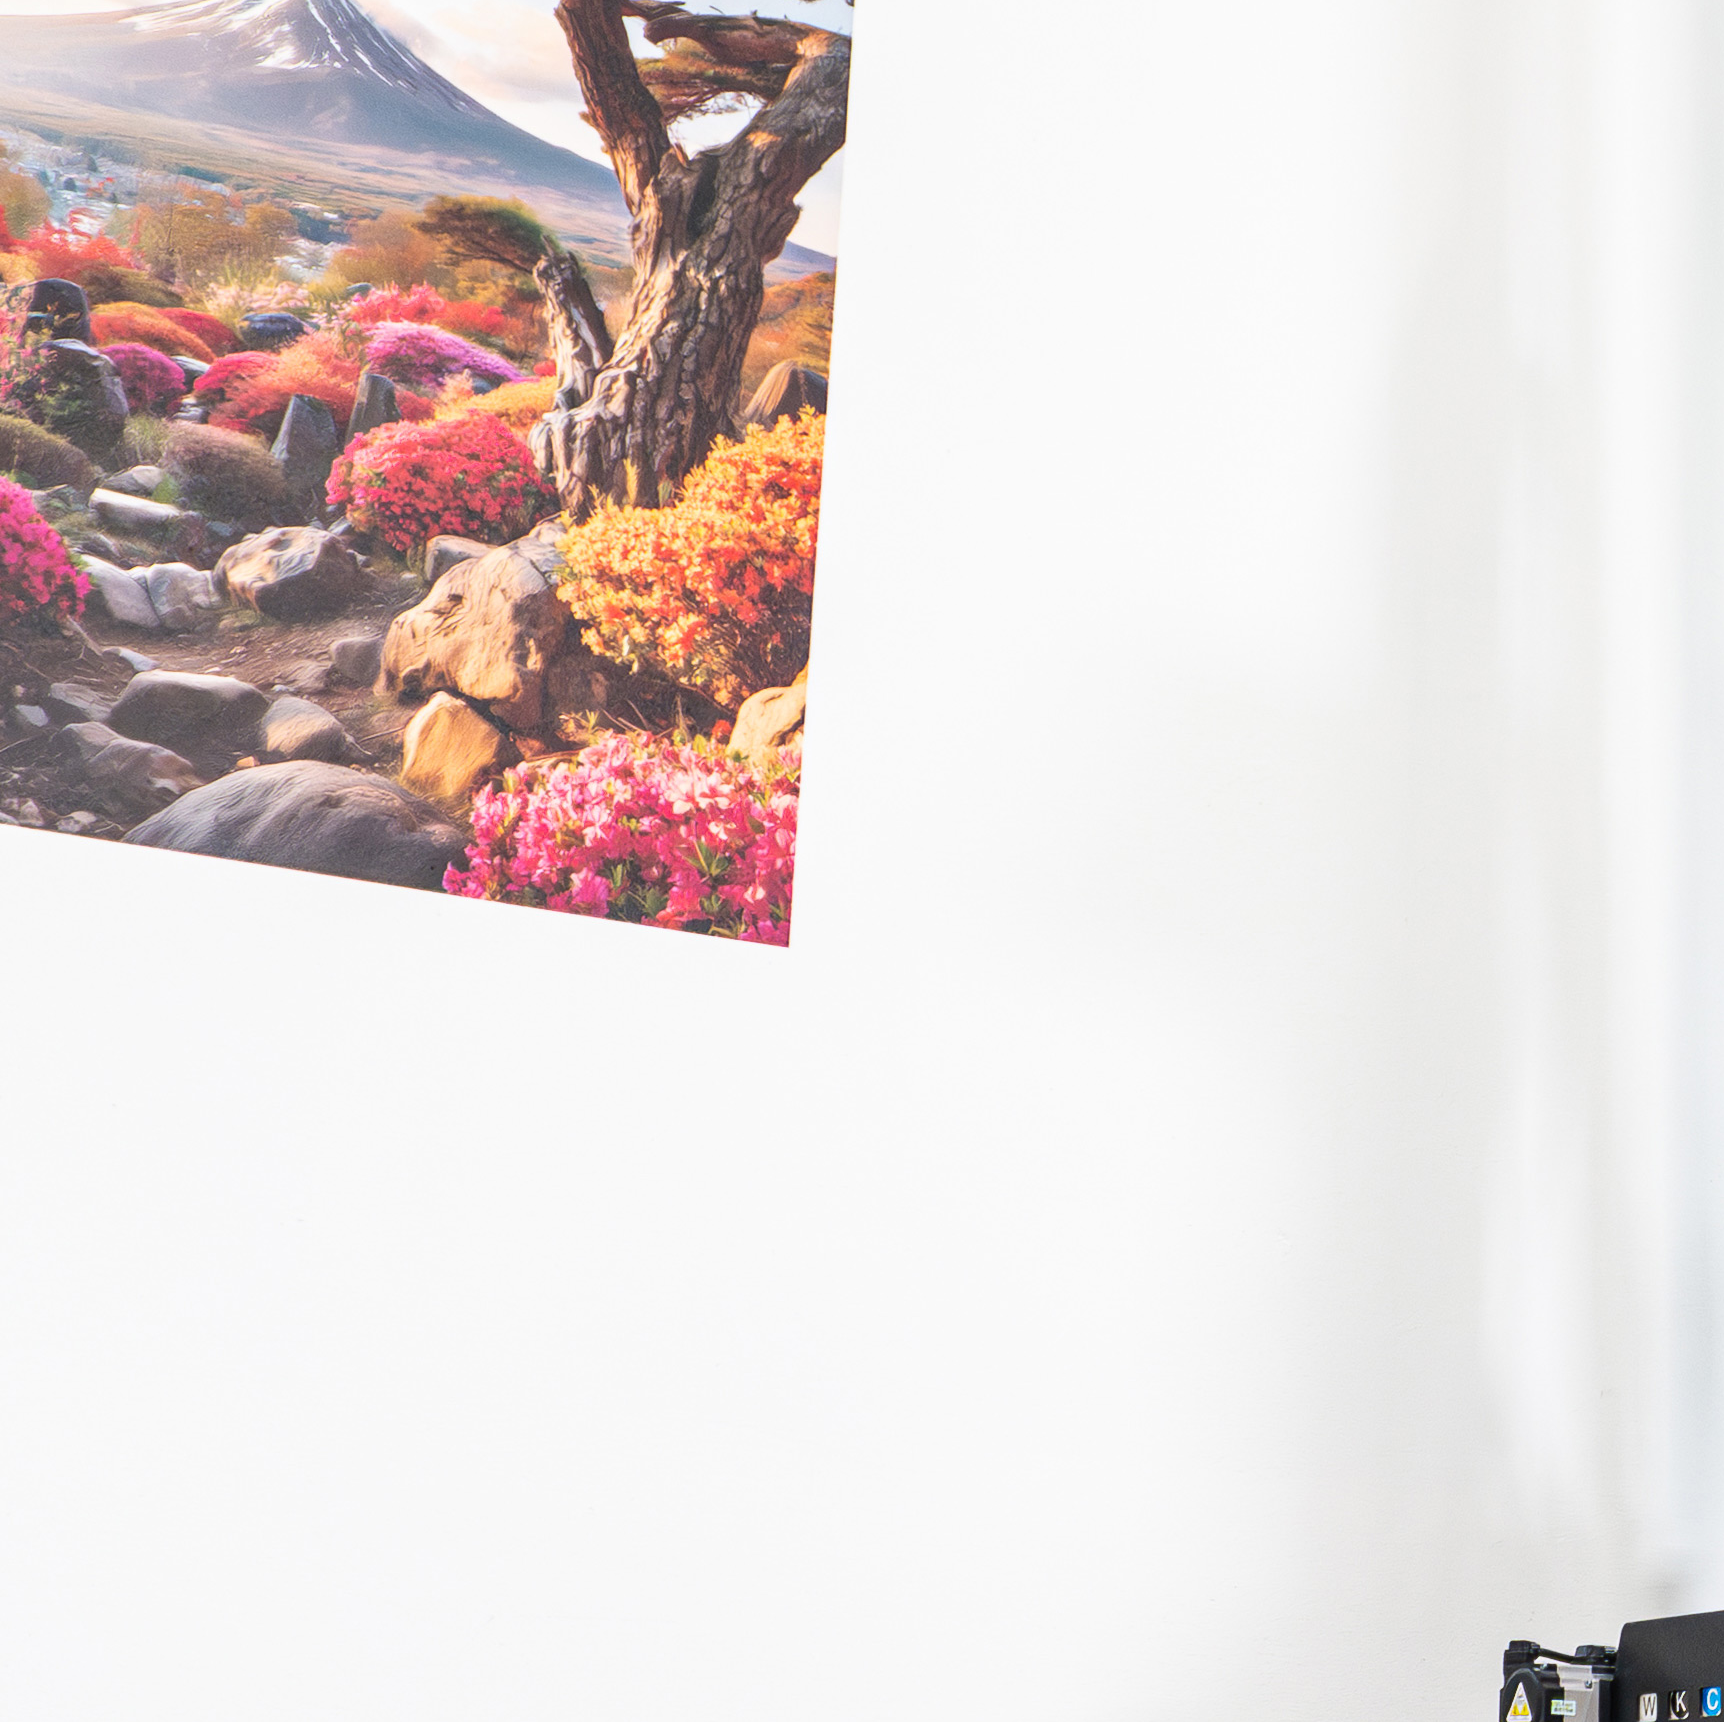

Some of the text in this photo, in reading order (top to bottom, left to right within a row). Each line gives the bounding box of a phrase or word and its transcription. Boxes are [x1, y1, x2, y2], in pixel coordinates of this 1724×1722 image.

[1643, 1695, 1656, 1717] W
[1675, 1690, 1687, 1713] K
[1706, 1687, 1719, 1711] C
